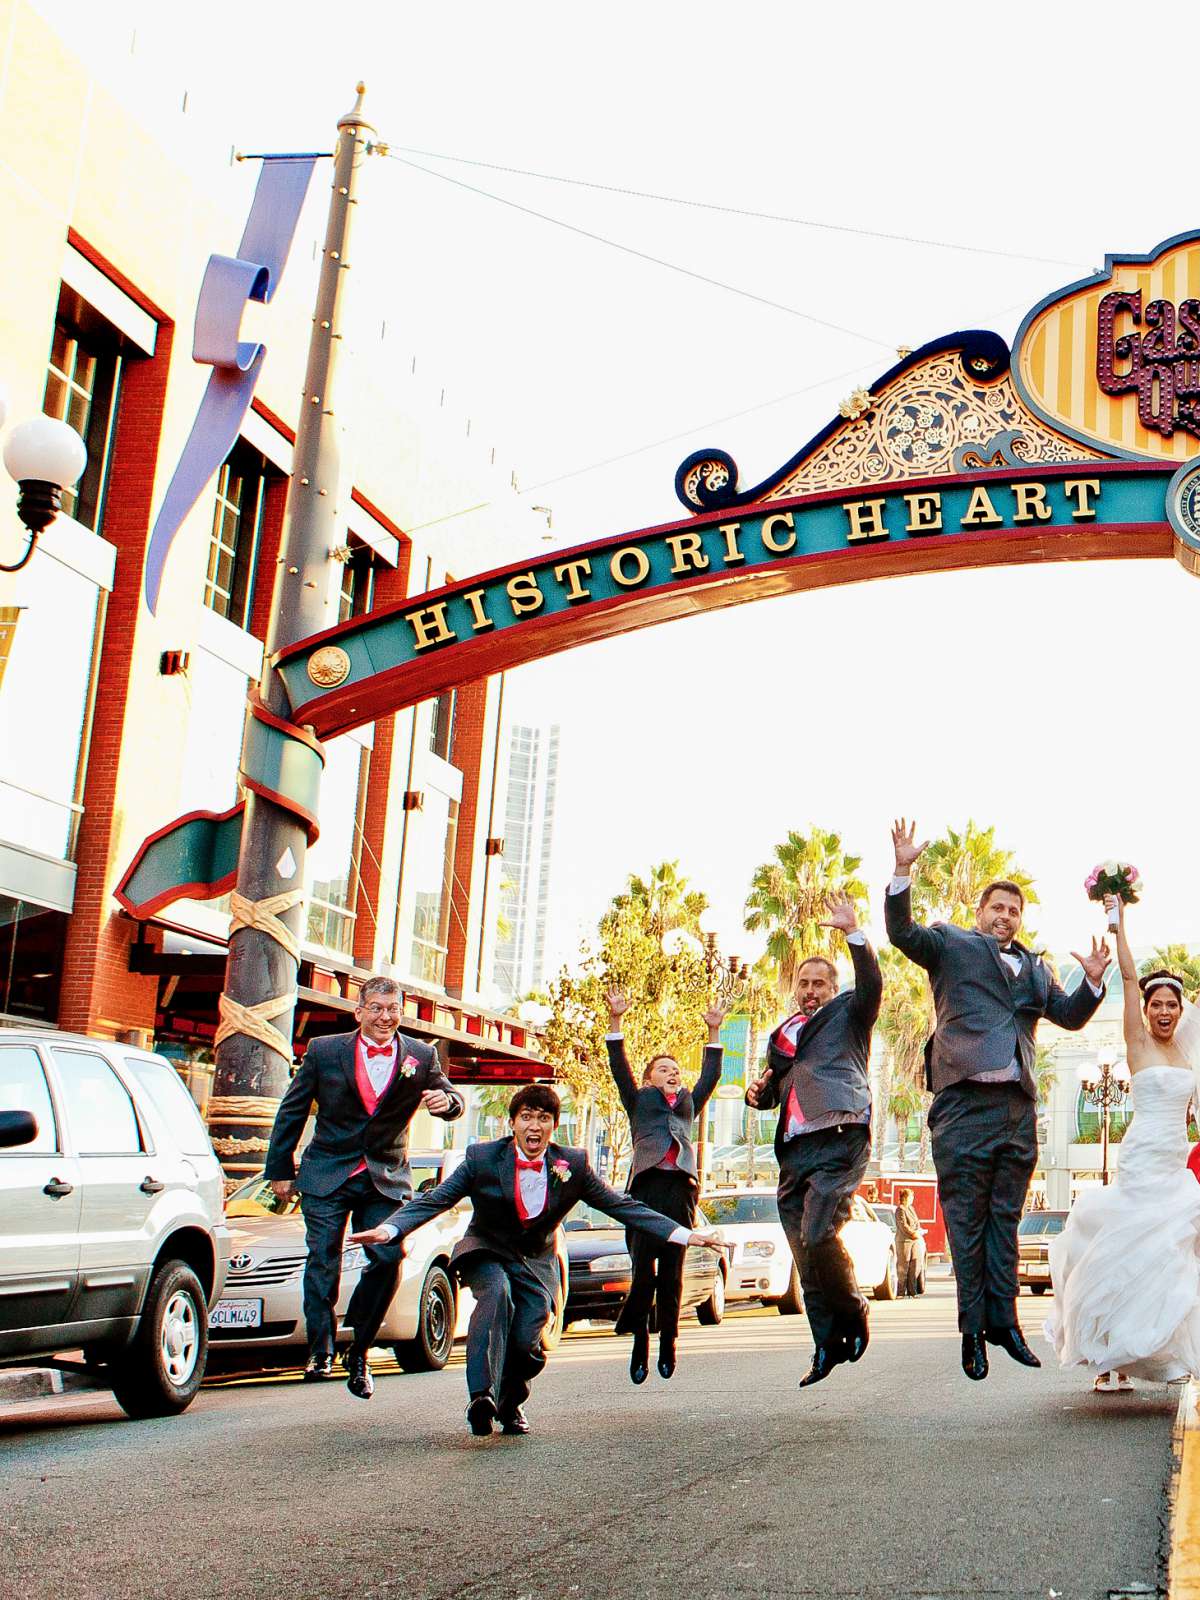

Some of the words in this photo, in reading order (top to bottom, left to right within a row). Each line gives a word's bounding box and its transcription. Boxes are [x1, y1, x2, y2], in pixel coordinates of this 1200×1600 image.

[405, 513, 796, 650] HISTORIC
[843, 479, 1100, 540] HEART
[210, 1310, 257, 1324] 6CLM449
